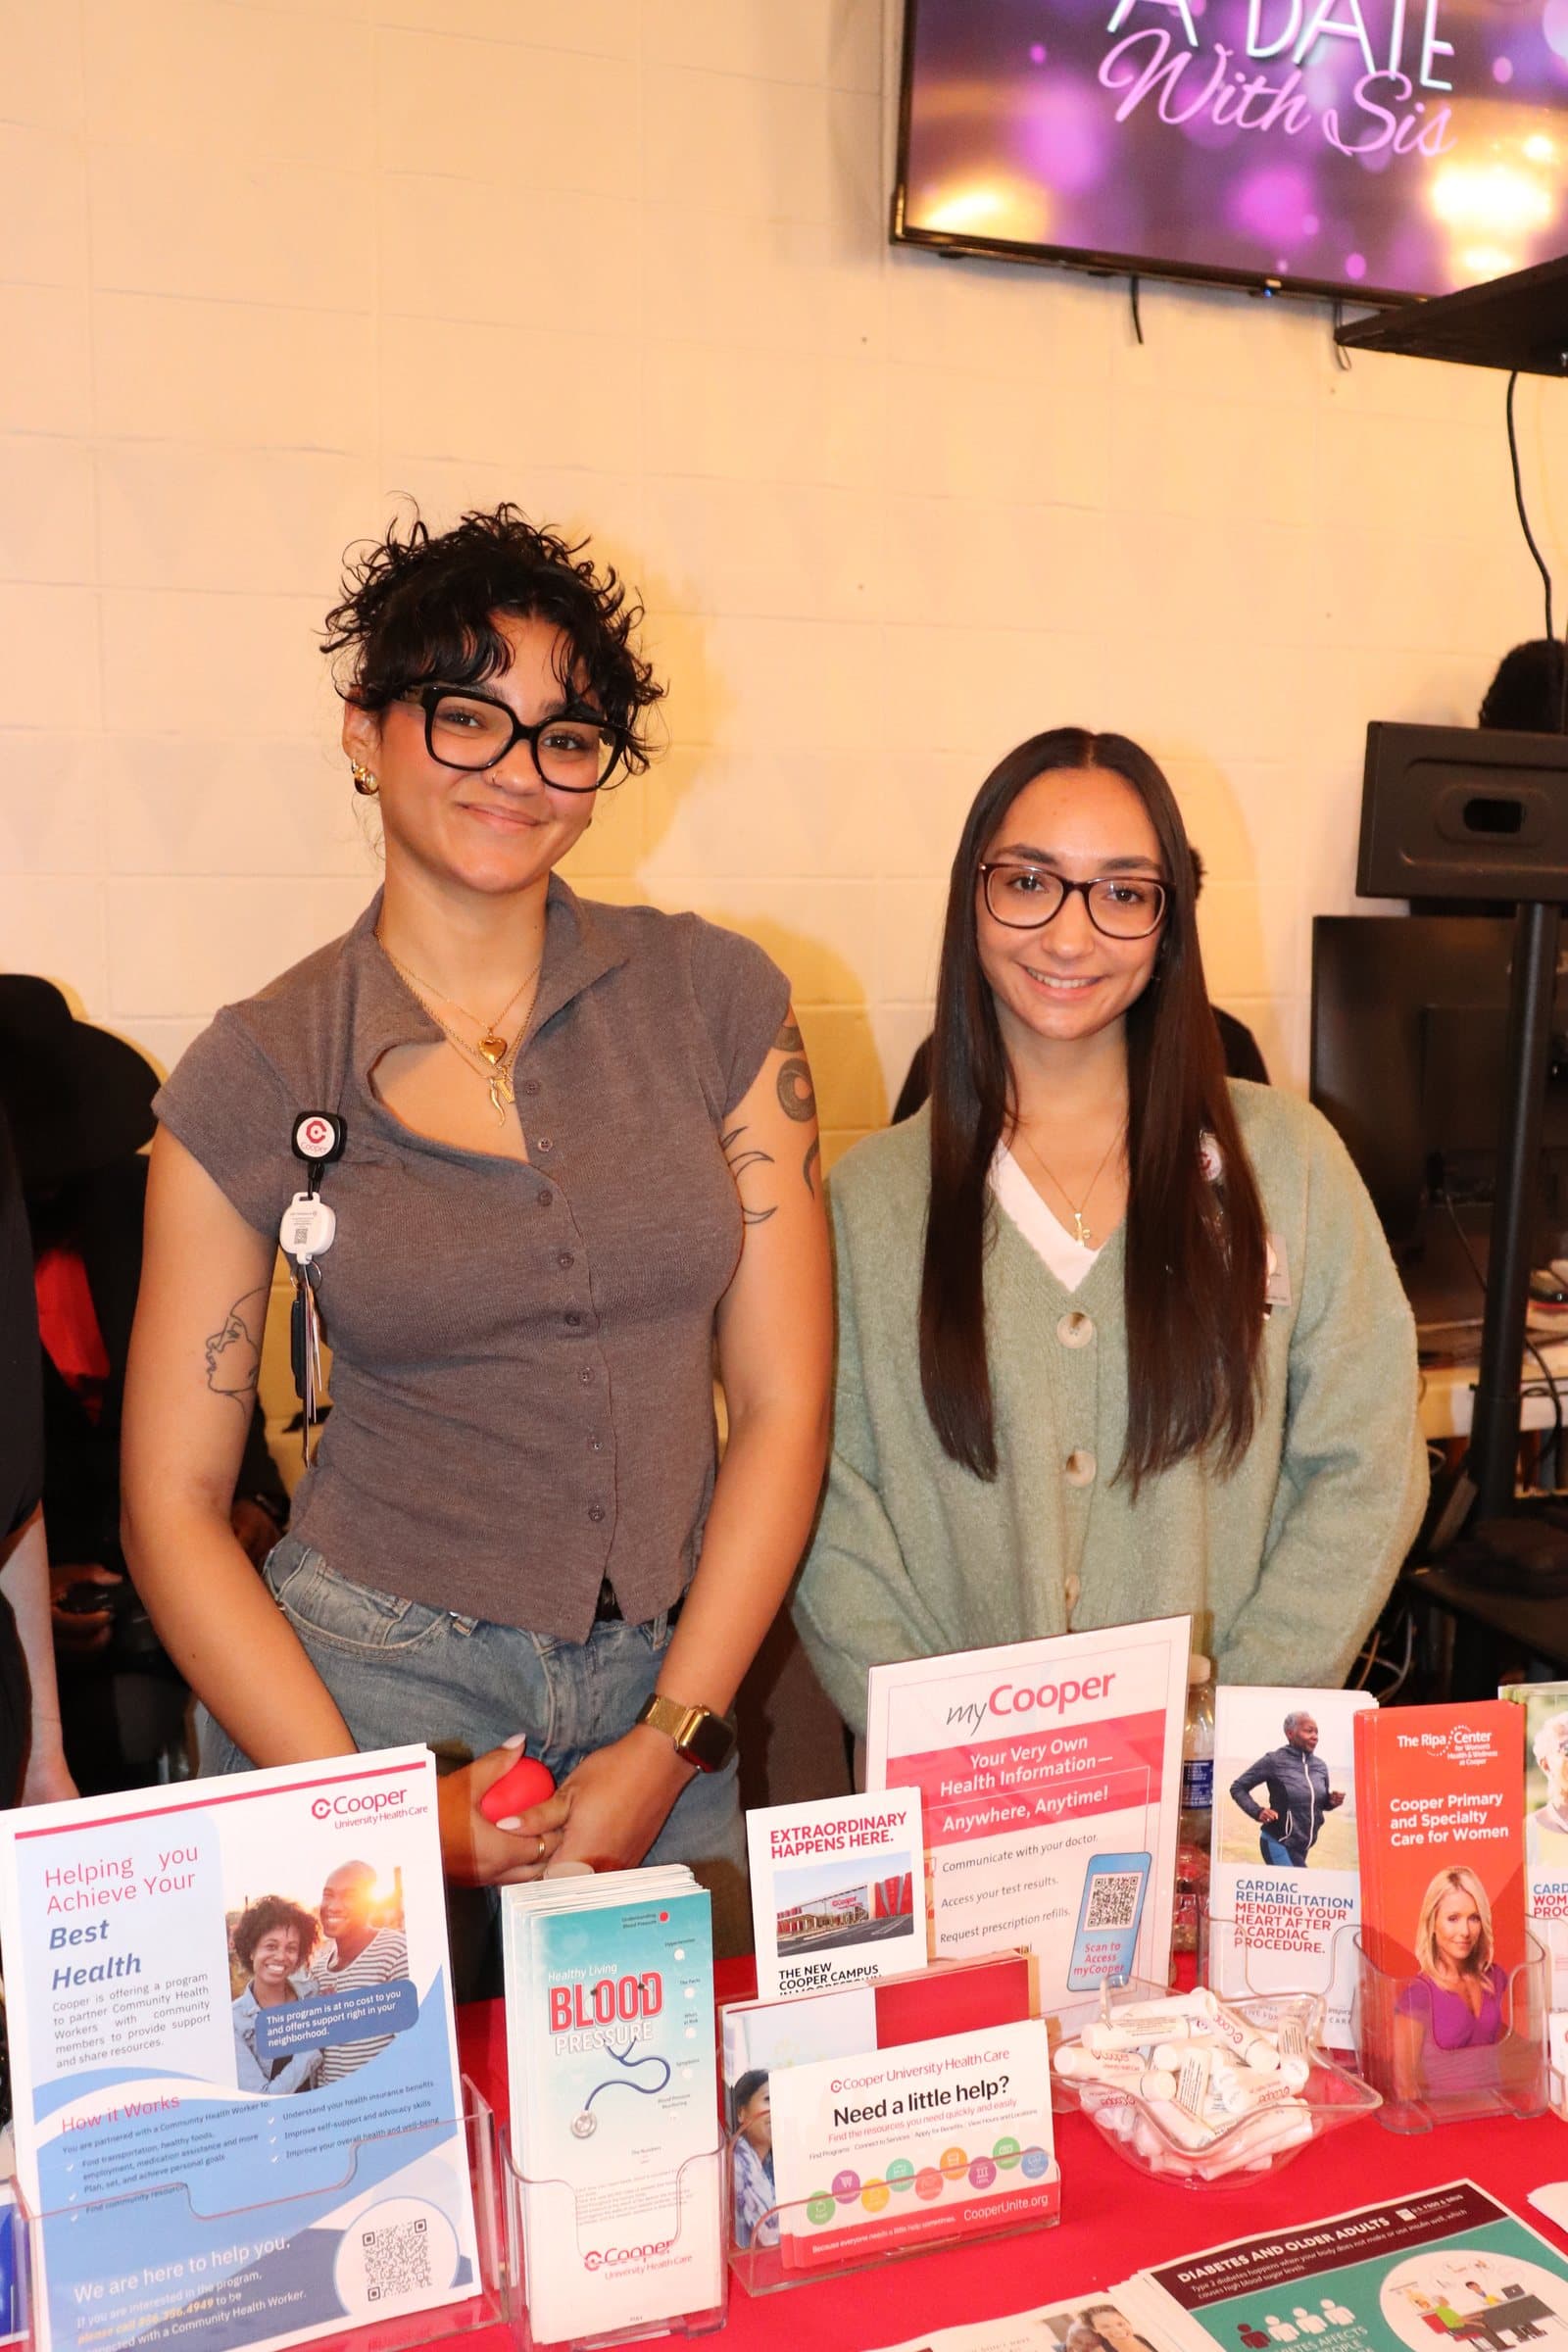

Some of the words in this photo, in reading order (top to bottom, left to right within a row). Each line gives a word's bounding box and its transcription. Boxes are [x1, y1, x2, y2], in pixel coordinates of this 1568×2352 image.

[1099, 28, 1310, 134] With
[1323, 71, 1458, 157] Sis
[970, 1752, 1006, 1770] Your
[1010, 1744, 1047, 1762] Very
[1051, 1738, 1088, 1753] Own
[1396, 1736, 1419, 1747] The
[1421, 1734, 1446, 1748] Ripa
[1454, 1732, 1492, 1743] Center
[941, 1774, 995, 1797] Health
[334, 1789, 407, 1814] Cooper
[943, 1805, 1031, 1833] Anywhere,
[1035, 1786, 1108, 1814] Anytime!
[1390, 1797, 1444, 1812] Cooper
[1447, 1793, 1503, 1807] Primary
[334, 1816, 378, 1829] University
[379, 1809, 408, 1821] Health
[409, 1806, 427, 1815] Care
[770, 1812, 906, 1843] EXTRAORDINARY
[1391, 1815, 1417, 1830] and
[1421, 1811, 1487, 1828] Specialty
[771, 1837, 845, 1859] HAPPENS
[850, 1830, 894, 1847] HERE.
[1391, 1834, 1424, 1846] Care
[1428, 1830, 1448, 1842] for
[1452, 1827, 1508, 1841] Women
[45, 1857, 133, 1888] Helping
[159, 1847, 198, 1871] you
[943, 1852, 1013, 1873] Communicate
[1015, 1845, 1038, 1858] with
[1041, 1840, 1062, 1855] your
[1065, 1835, 1098, 1847] doctor.
[47, 1885, 136, 1915] Achieve
[144, 1873, 196, 1895] Your
[941, 1895, 974, 1908] Access
[977, 1888, 999, 1904] your
[1003, 1884, 1020, 1895] test
[1023, 1878, 1058, 1889] results.
[1236, 1880, 1298, 1893] CARDIAC
[1236, 1890, 1353, 1909] REHABILITATION
[940, 1928, 984, 1944] Request
[982, 1915, 1040, 1936] prescription
[1043, 1908, 1070, 1921] refills.
[1235, 1914, 1282, 1927] HEART
[1286, 1918, 1331, 1931] AFTER
[1236, 1902, 1302, 1917] MENDING
[1307, 1908, 1347, 1920] YOUR
[49, 1920, 110, 1950] Best
[1085, 1942, 1107, 1952] Scan
[1111, 1942, 1120, 1951] to
[1234, 1927, 1244, 1936] A
[1248, 1927, 1309, 1940] CARDIAC
[1235, 1937, 1325, 1954] PROCEDURE.
[52, 1953, 141, 1990] Health
[548, 1966, 587, 1982] Healthy
[589, 1962, 617, 1977] Living
[779, 1968, 801, 1980] THE
[805, 1962, 831, 1977] NEW
[1074, 1964, 1124, 1976] myCooper
[1085, 1952, 1116, 1962] Access
[779, 1975, 827, 1990] COOPER
[831, 1965, 878, 1982] CAMPUS
[52, 1998, 89, 2012] Cooper
[110, 1984, 149, 1999] offering
[166, 1974, 208, 1989] program
[70, 2009, 107, 2024] partner
[113, 1995, 171, 2014] Community
[176, 1986, 209, 1999] Health
[267, 2013, 284, 2025] This
[287, 2007, 322, 2021] program
[357, 1996, 373, 2005] cost
[386, 1990, 402, 2002] you
[550, 1972, 663, 2035] BLOOD
[55, 2025, 97, 2038] Workers
[116, 2016, 136, 2027] with
[154, 2001, 210, 2019] community
[56, 2037, 104, 2053] members
[128, 2024, 166, 2038] provide
[172, 2015, 211, 2030] support
[268, 2026, 283, 2036] and
[285, 2019, 311, 2032] offers
[313, 2013, 345, 2027] support
[347, 2008, 366, 2020] right
[368, 2005, 375, 2014] in
[378, 2003, 396, 2015] your
[269, 2027, 329, 2046] neighborhood.
[556, 2020, 654, 2056] PRESSURE
[57, 2056, 75, 2068] and
[79, 2051, 108, 2063] share
[111, 2039, 164, 2055] resources.
[843, 2073, 883, 2090] Cooper
[887, 2061, 943, 2082] University
[946, 2051, 982, 2071] Health
[984, 2049, 1009, 2062] Care
[63, 2116, 101, 2132] How
[106, 2110, 118, 2123] it
[124, 2095, 180, 2118] Works
[834, 2099, 887, 2127] Need
[893, 2100, 904, 2114] a
[908, 2089, 951, 2112] little
[956, 2076, 1009, 2101] help?
[828, 2131, 847, 2143] Find
[849, 2127, 862, 2139] the
[864, 2121, 905, 2135] resources
[906, 2117, 922, 2129] you
[923, 2113, 945, 2125] need
[947, 2106, 974, 2121] quickly
[977, 2103, 992, 2114] and
[994, 2098, 1017, 2111] easily
[964, 2195, 1048, 2222] CooperUnite.org
[1178, 2254, 1250, 2283] DIABETES
[1251, 2245, 1284, 2263] AND
[1286, 2233, 1334, 2252] OLDER
[1336, 2217, 1391, 2240] ADULTS
[74, 2283, 104, 2304] We
[110, 2276, 138, 2295] are
[143, 2264, 184, 2285] here
[188, 2258, 206, 2274] to
[212, 2243, 249, 2268] help
[254, 2237, 290, 2259] you.
[138, 2327, 161, 2345] with
[163, 2328, 170, 2337] a
[172, 2307, 230, 2335] Community
[232, 2299, 266, 2318] Health
[268, 2289, 306, 2307] Worker.
